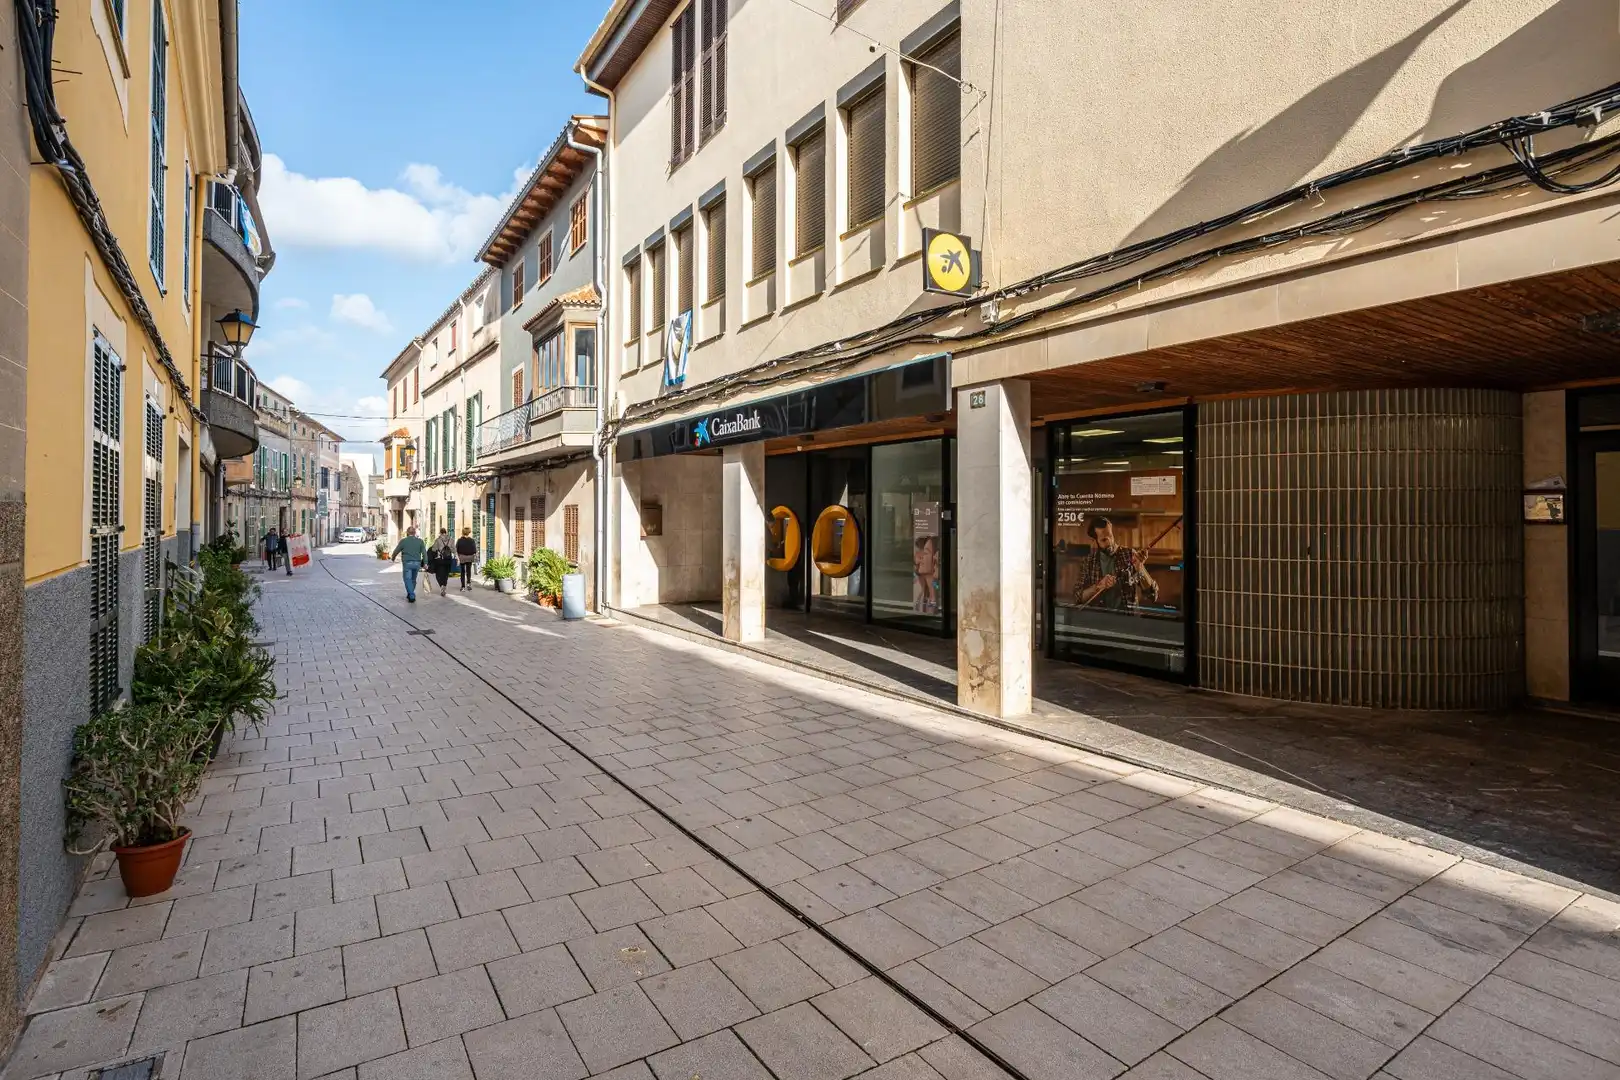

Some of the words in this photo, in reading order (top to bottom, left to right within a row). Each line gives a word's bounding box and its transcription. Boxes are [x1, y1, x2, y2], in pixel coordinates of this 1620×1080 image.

[973, 395, 984, 405] 28
[711, 409, 761, 436] CaixaBank
[1057, 512, 1076, 522] 250
